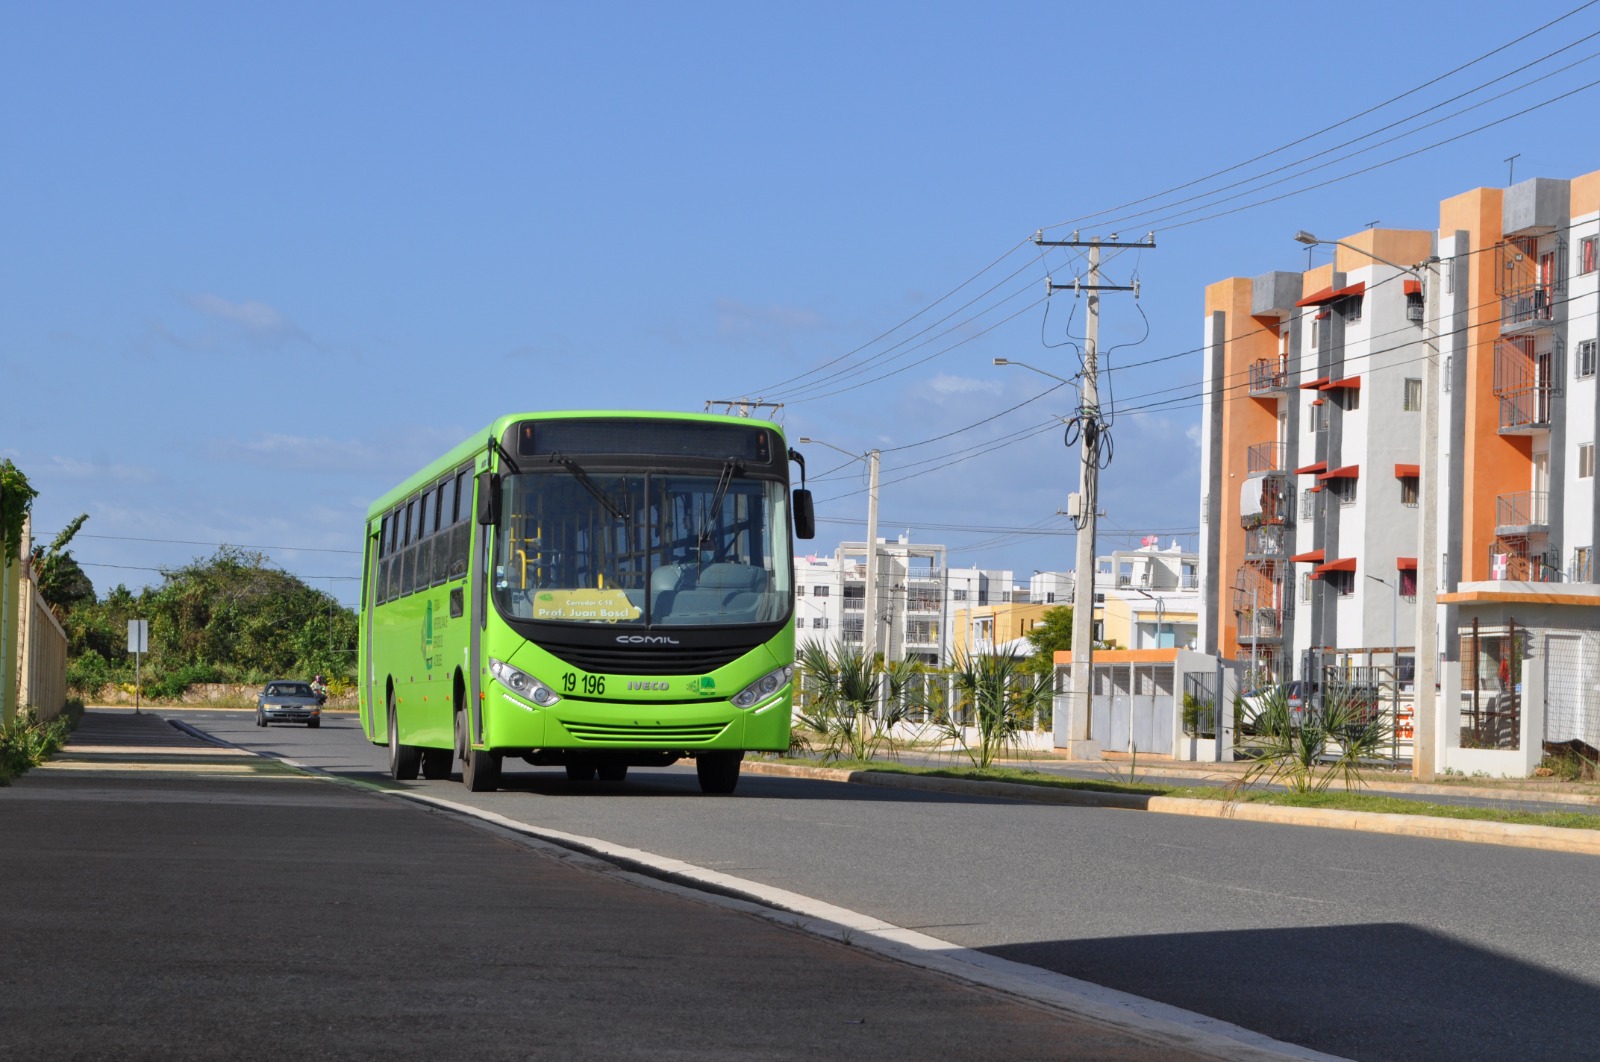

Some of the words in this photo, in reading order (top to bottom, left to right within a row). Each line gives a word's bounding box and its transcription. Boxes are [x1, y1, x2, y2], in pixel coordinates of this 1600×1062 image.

[539, 608, 566, 617] Prof.
[569, 608, 596, 617] Juan
[616, 635, 679, 644] COMIL
[561, 672, 576, 692] 19
[581, 674, 605, 695] 196
[627, 681, 669, 691] IVECO
